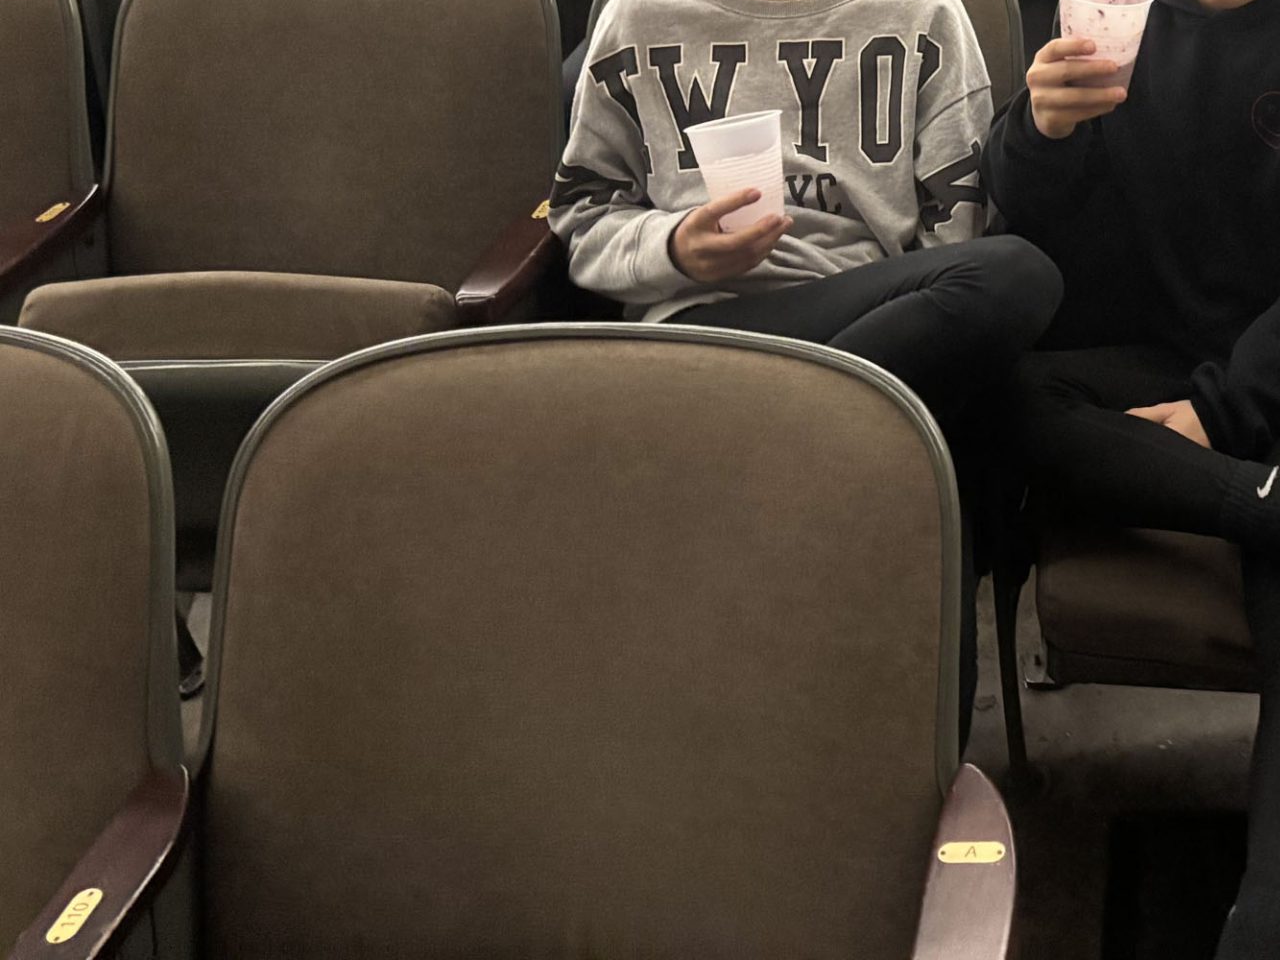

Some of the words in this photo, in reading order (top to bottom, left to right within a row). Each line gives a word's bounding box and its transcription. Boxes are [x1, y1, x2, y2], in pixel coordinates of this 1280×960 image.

[785, 172, 843, 215] YC
[964, 845, 977, 858] A
[60, 902, 90, 927] 110
